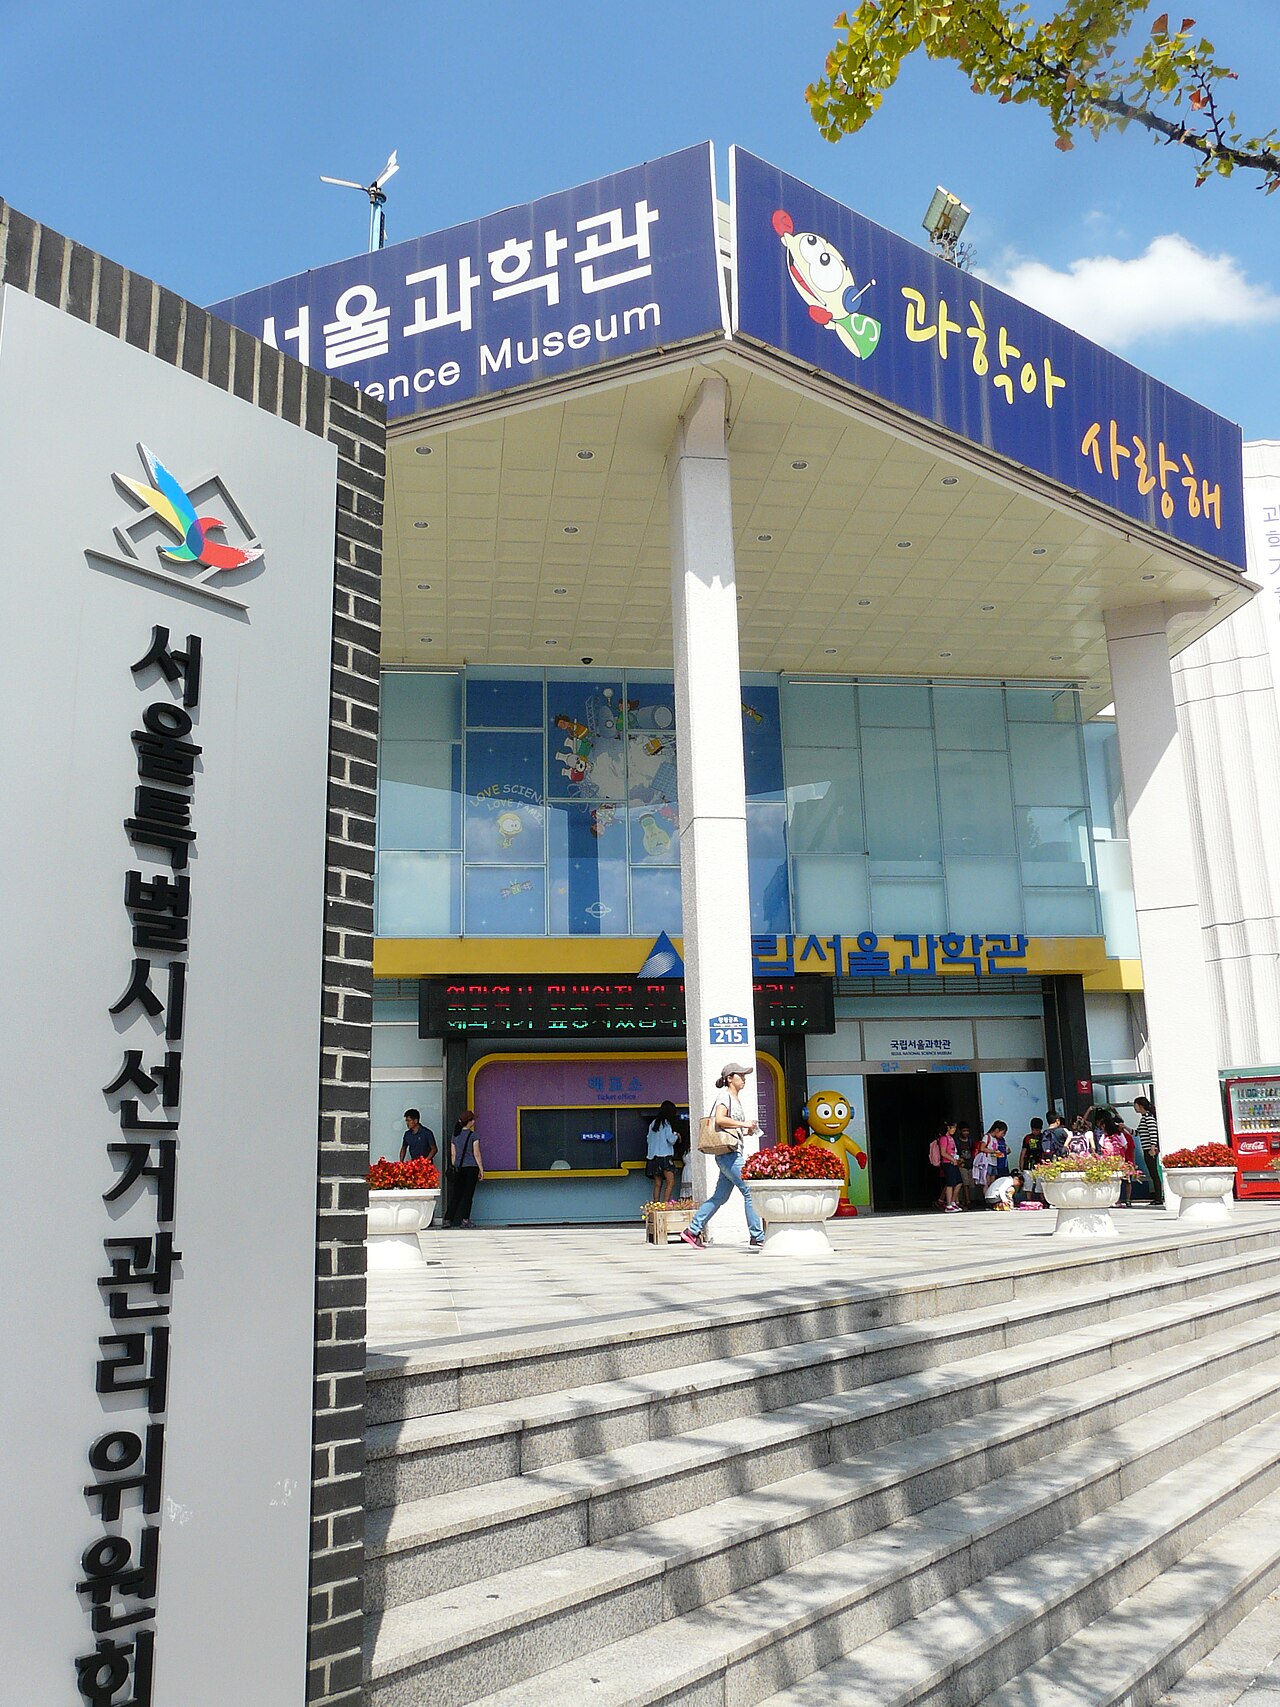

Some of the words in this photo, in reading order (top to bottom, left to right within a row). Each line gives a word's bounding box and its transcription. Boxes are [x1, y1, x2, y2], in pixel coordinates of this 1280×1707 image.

[479, 302, 661, 376] Museum
[901, 287, 1066, 408] 과학아
[1081, 420, 1220, 529] 사랑해
[470, 784, 500, 807] LOVE
[487, 798, 513, 811] LOVE
[751, 931, 1028, 977] 립서울과학관
[715, 1029, 743, 1043] 215
[890, 1039, 951, 1050] 국립서울과학관
